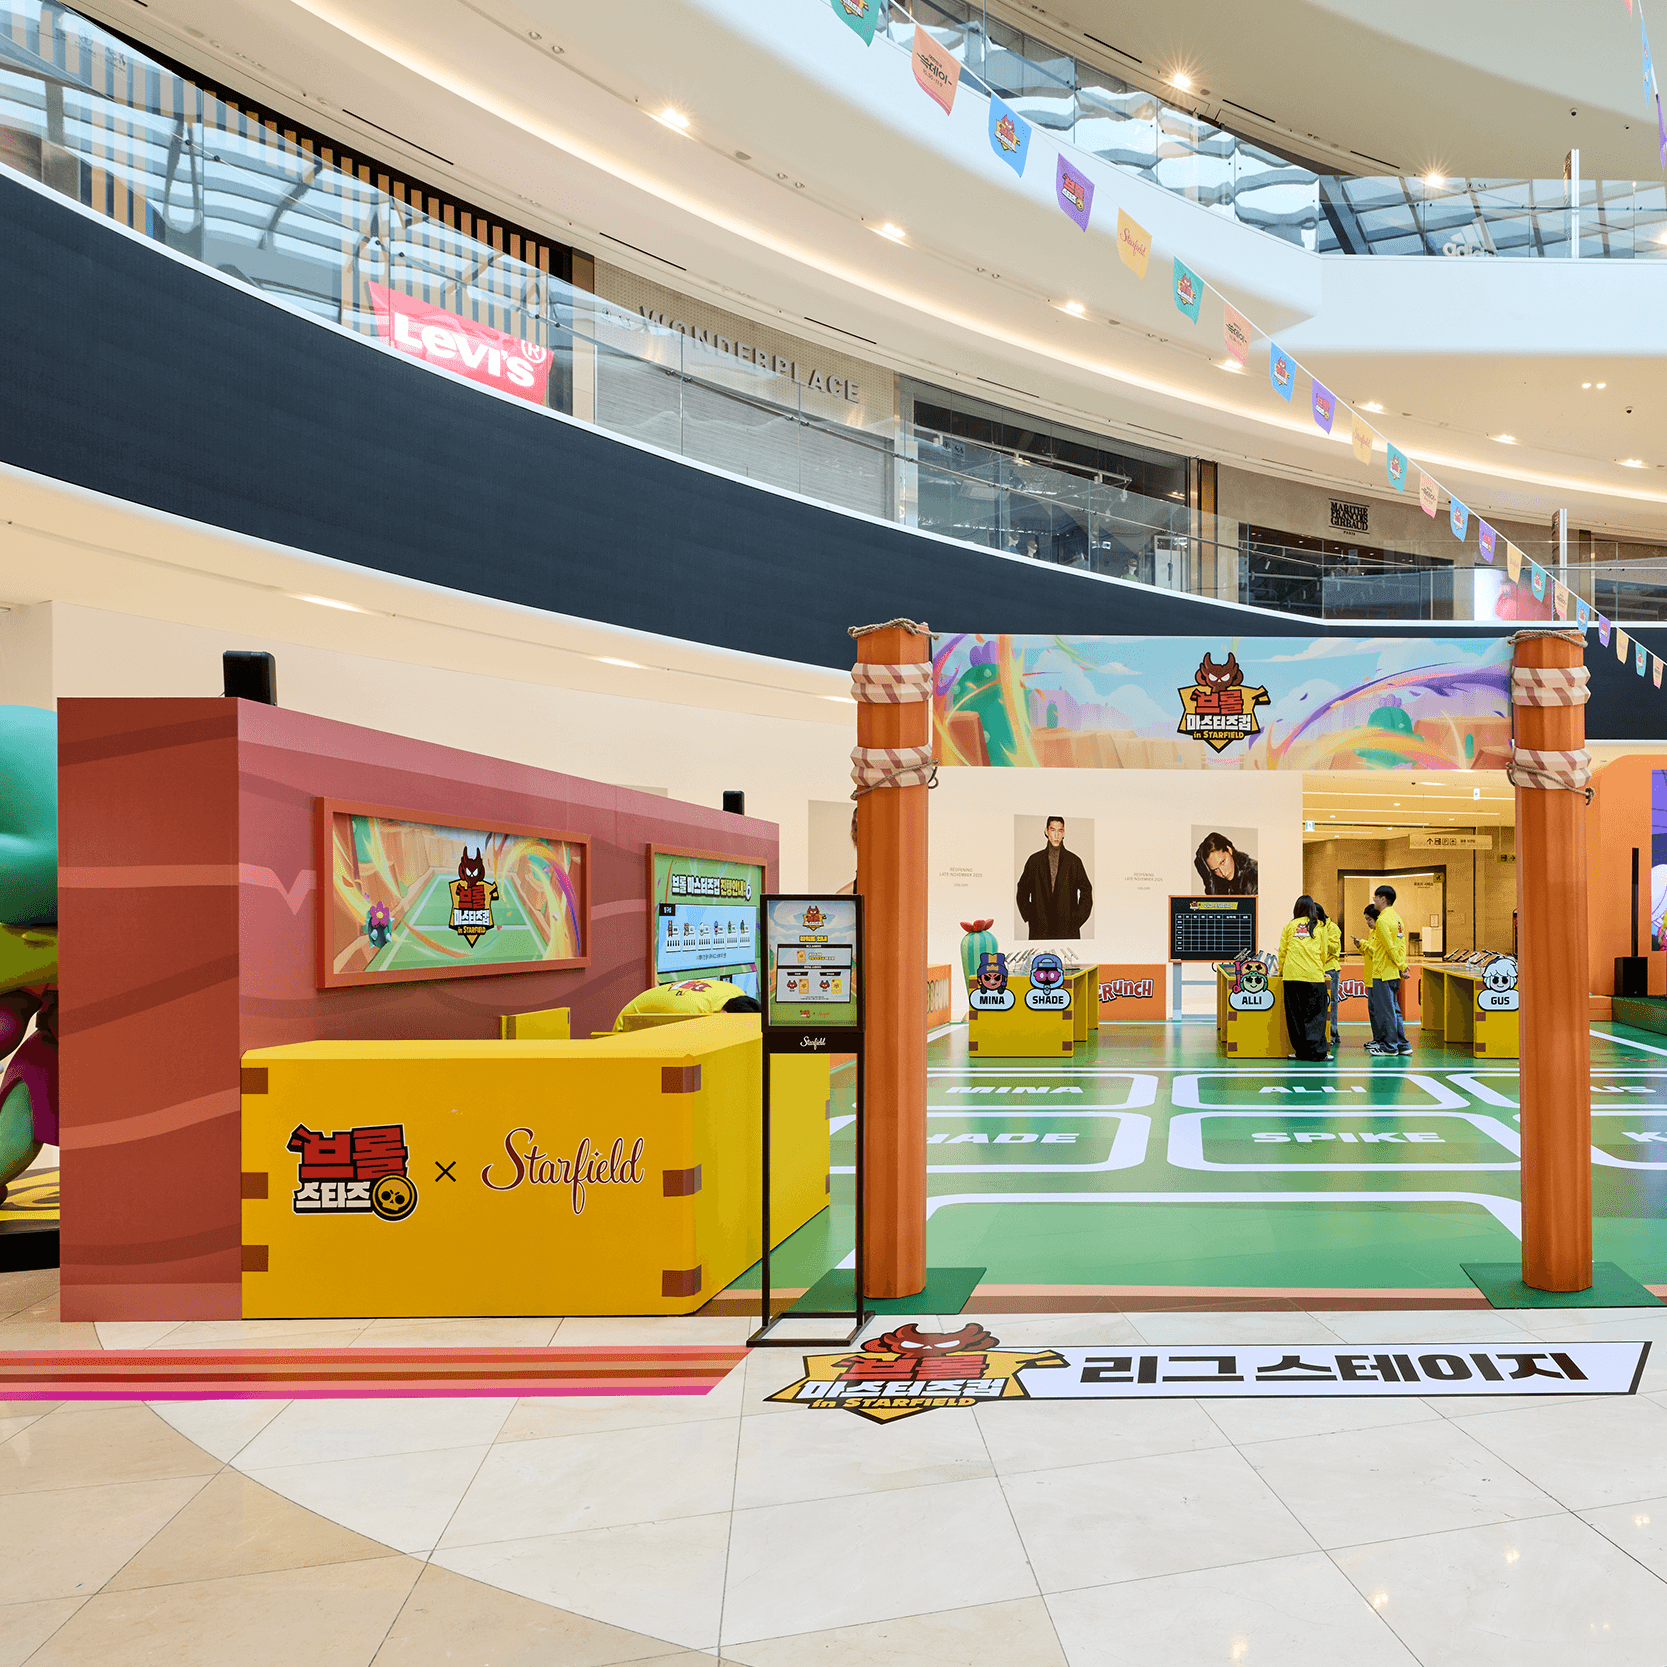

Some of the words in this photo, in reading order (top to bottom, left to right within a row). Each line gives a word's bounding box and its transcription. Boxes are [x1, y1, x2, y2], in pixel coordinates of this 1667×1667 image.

[639, 305, 861, 403] WONDERPLACE
[1190, 688, 1243, 714] 브롤
[1186, 714, 1252, 731] 마스터즈컵
[1193, 730, 1202, 739] in
[1203, 731, 1245, 739] STARFIELD
[979, 996, 1005, 1005] MINA
[1032, 996, 1064, 1005] SHADE
[1241, 996, 1262, 1005] ALLI
[1490, 996, 1510, 1006] GUS
[945, 1086, 1084, 1094] MINA
[1258, 1086, 1368, 1094] ALLI
[1590, 1085, 1657, 1093] US
[1251, 1132, 1446, 1143] SPIKE
[287, 1124, 409, 1180] 브롤
[481, 1127, 645, 1214] Starfield
[295, 1181, 372, 1209] 스타즈
[831, 1355, 990, 1380] 브롤
[1080, 1355, 1244, 1384] 리그
[1256, 1353, 1588, 1383] 스테이지
[796, 1378, 1007, 1398] 마스터즈컵
[811, 1398, 837, 1409] in
[844, 1397, 977, 1408] STARFIELD
